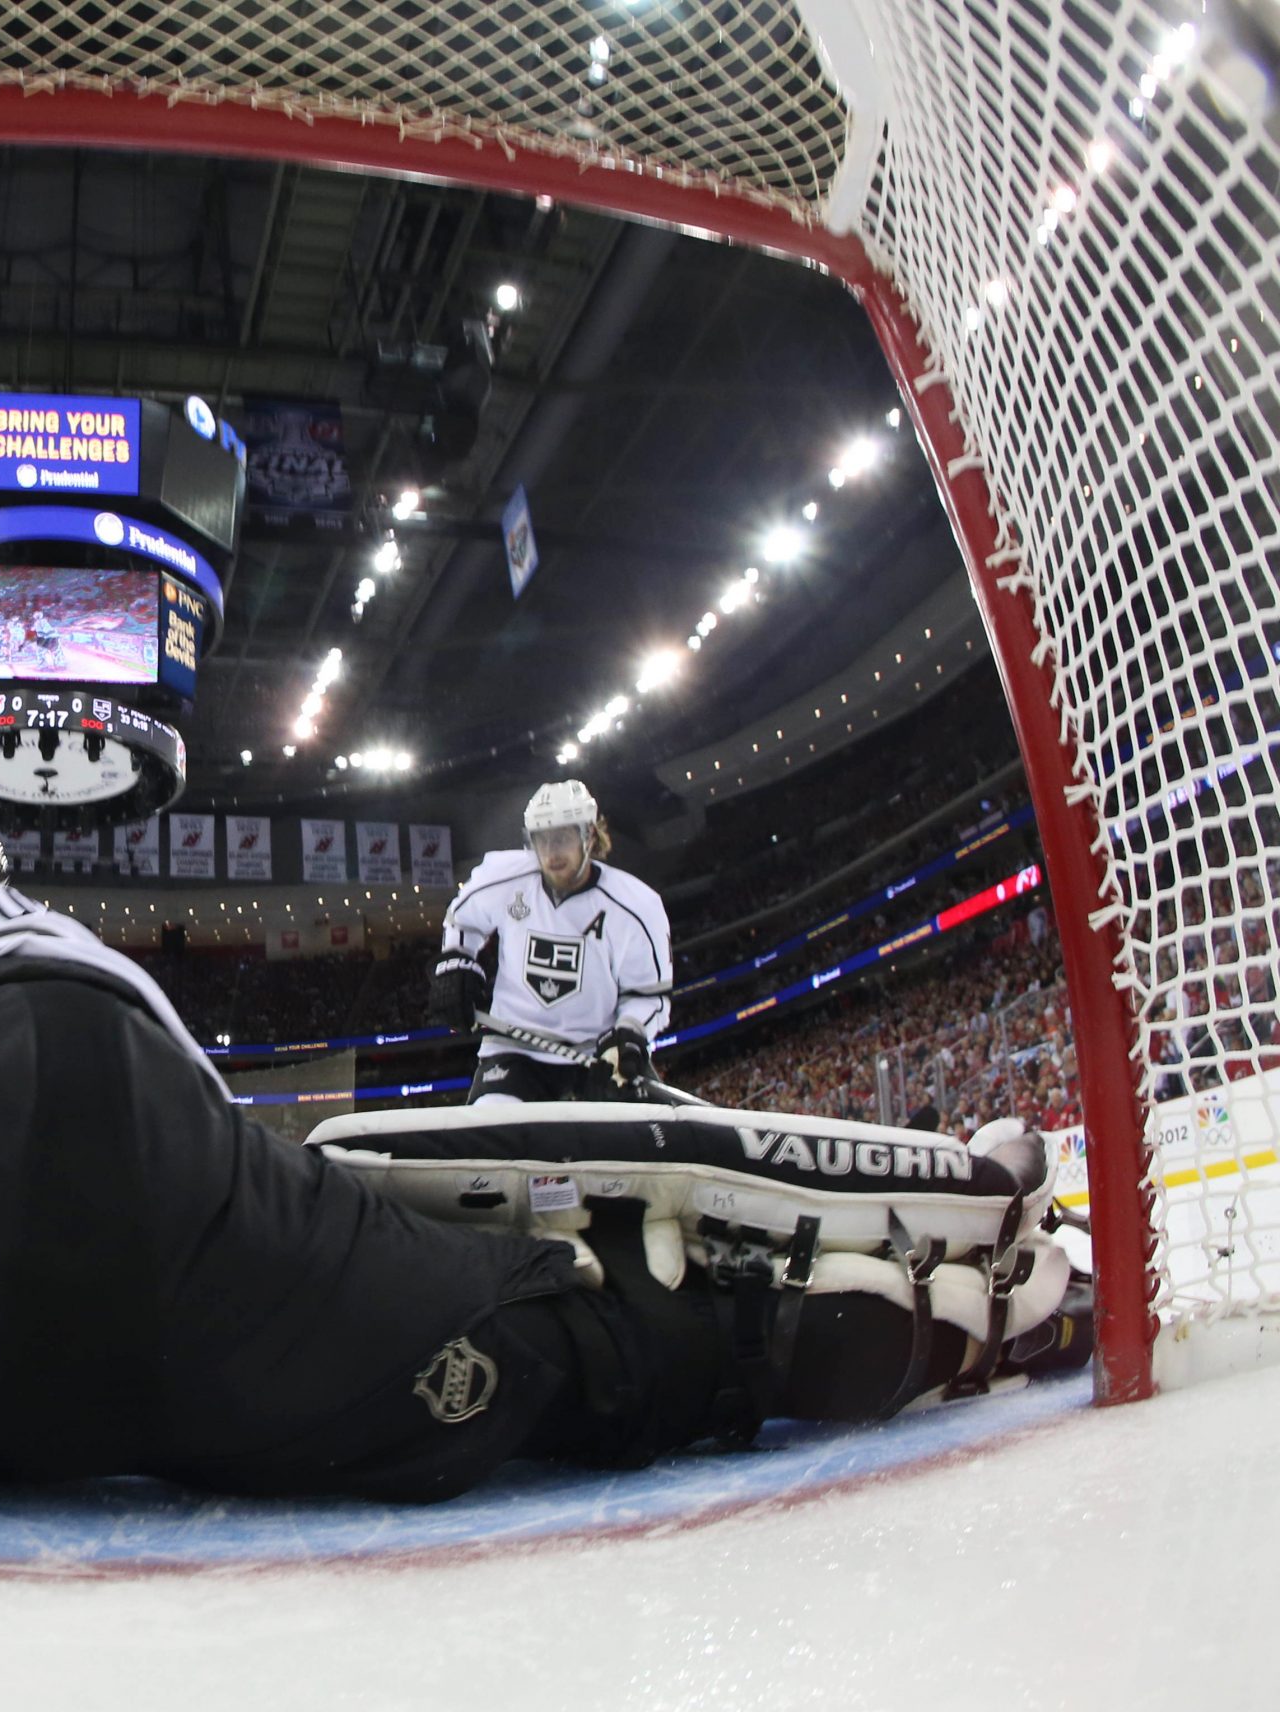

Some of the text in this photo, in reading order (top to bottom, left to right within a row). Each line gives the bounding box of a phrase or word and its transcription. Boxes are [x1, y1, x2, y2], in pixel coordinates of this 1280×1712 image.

[67, 411, 125, 437] YOUR
[40, 469, 99, 488] Prudential
[129, 526, 197, 577] Prudential
[178, 589, 204, 620] PNC
[169, 609, 195, 641] Bank
[165, 637, 196, 671] Devils
[11, 696, 23, 711] 0
[72, 698, 82, 713] 0
[27, 709, 69, 728] 7:17
[81, 718, 105, 731] SOG
[582, 909, 606, 940] A
[529, 939, 579, 970] LA
[435, 957, 487, 982] BAUE
[1158, 1125, 1189, 1146] 2012
[735, 1126, 973, 1181] VAUGHN
